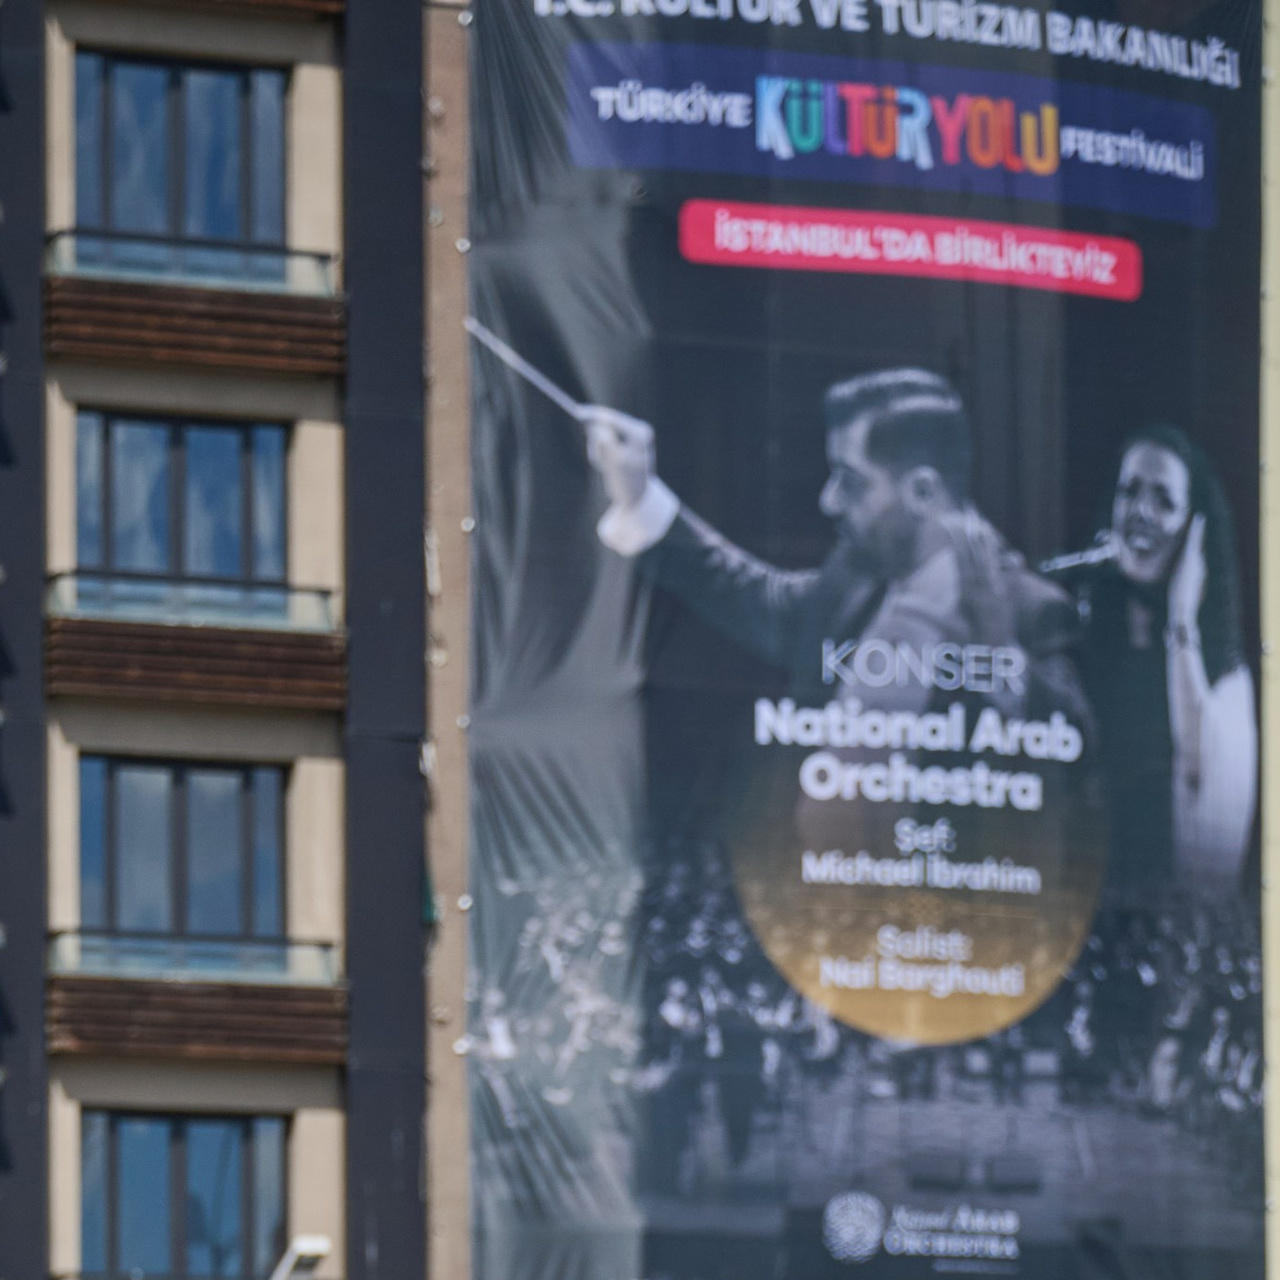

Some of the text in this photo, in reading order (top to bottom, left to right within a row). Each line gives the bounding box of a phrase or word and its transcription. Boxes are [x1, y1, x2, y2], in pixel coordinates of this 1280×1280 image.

[810, 0, 870, 32] VE
[1046, 11, 1241, 89] BAKANLIĞI
[590, 80, 753, 128] TÜRKİYE
[1061, 127, 1205, 182] FESTİVALİ
[715, 208, 1118, 285] İSTANBUL'DA BİRLİKTEYİZ
[822, 638, 1028, 695] KONSER
[754, 697, 1083, 762] National Arab
[799, 751, 1042, 811] Orchestra
[801, 851, 920, 886] Michael
